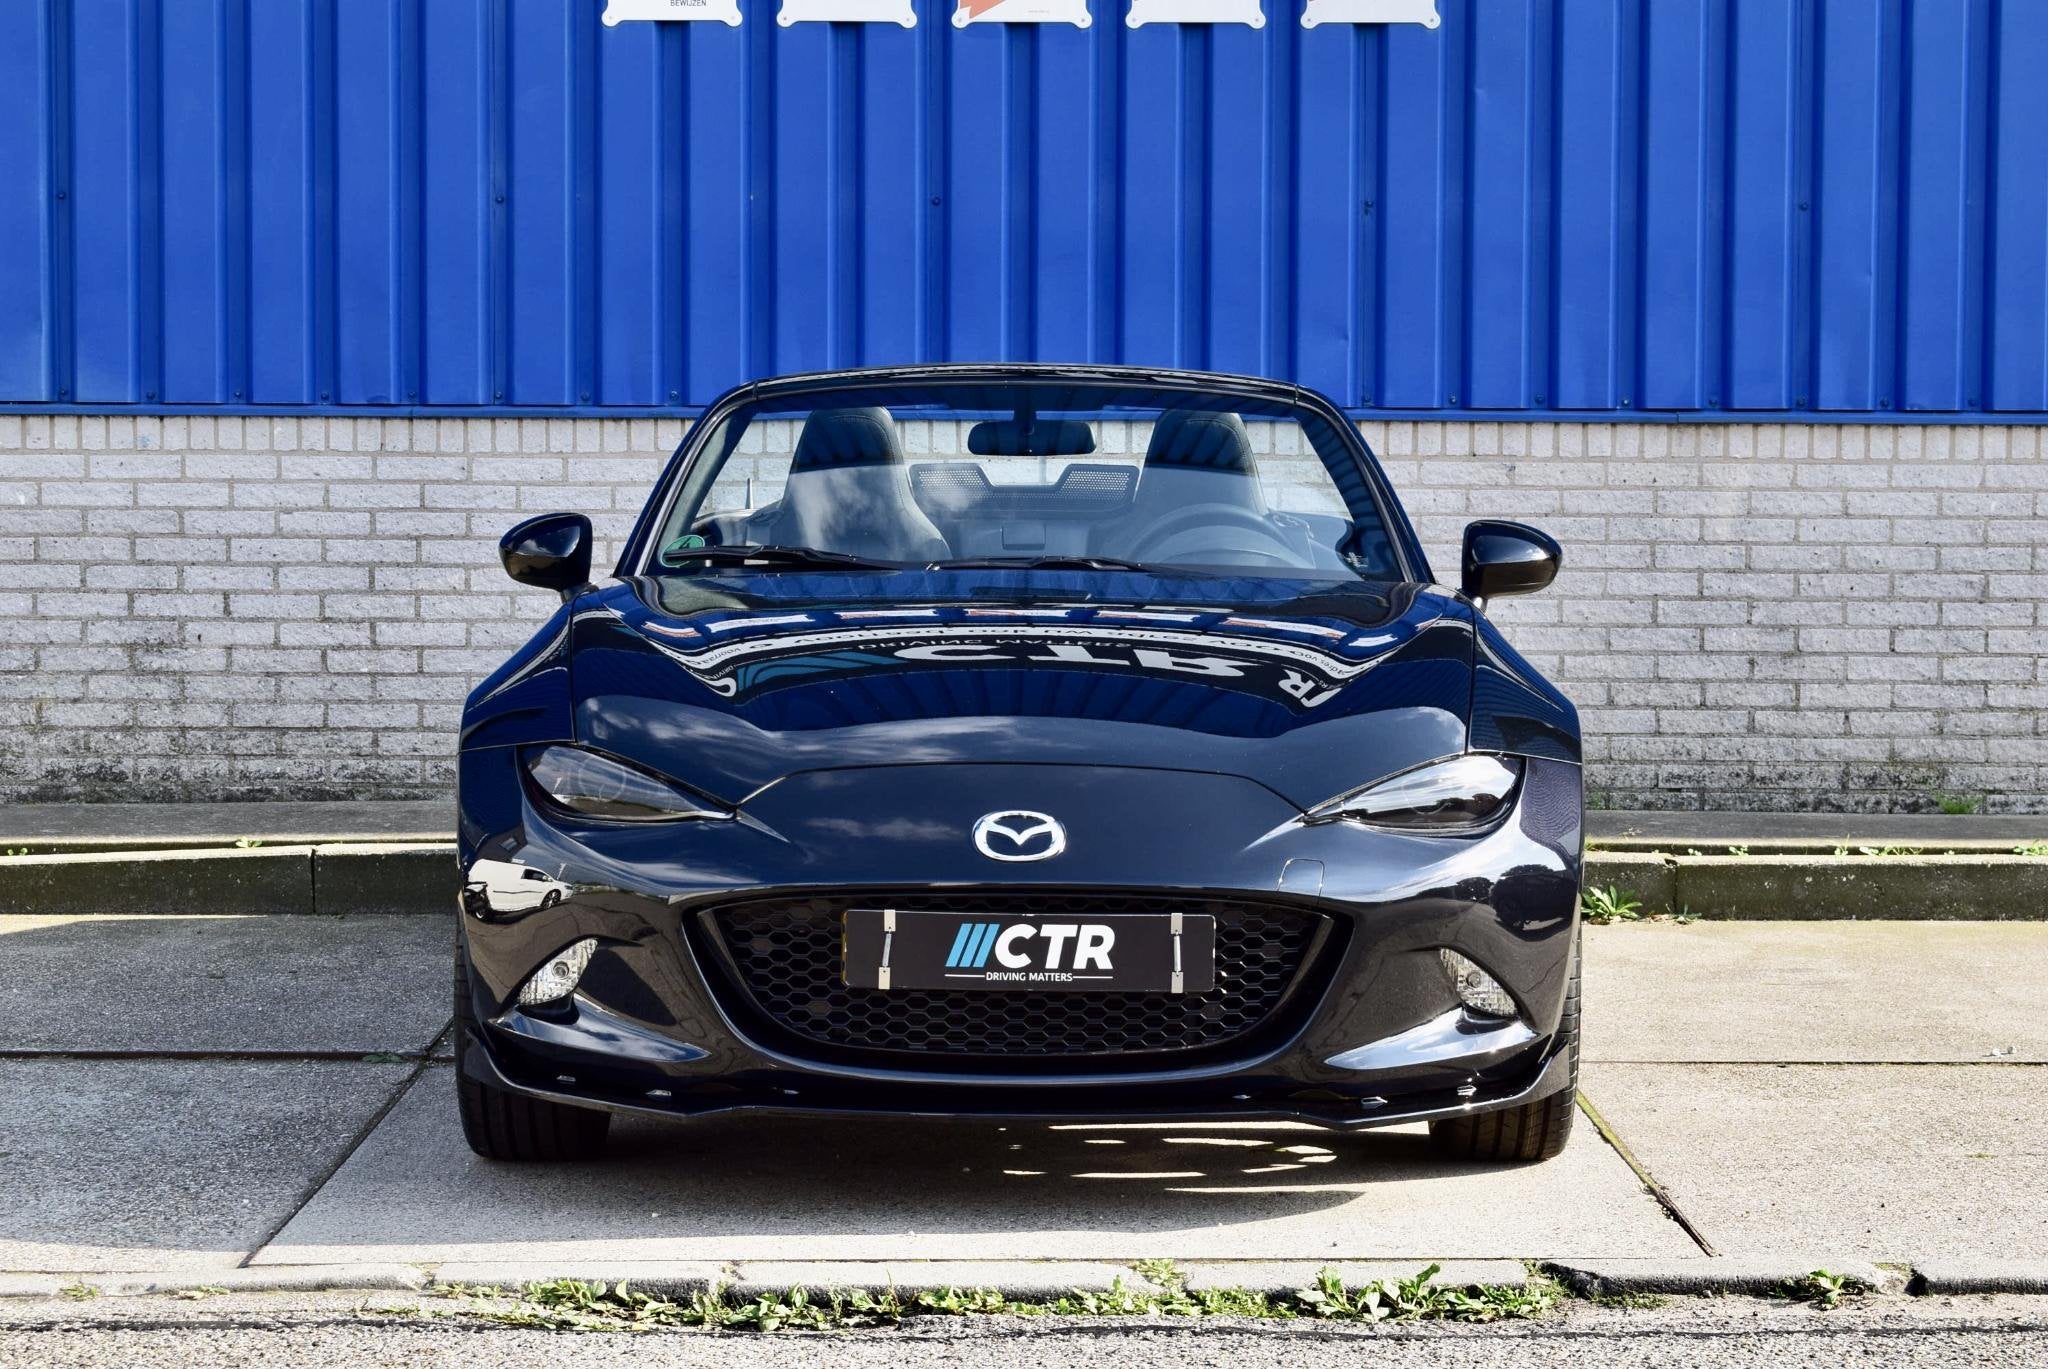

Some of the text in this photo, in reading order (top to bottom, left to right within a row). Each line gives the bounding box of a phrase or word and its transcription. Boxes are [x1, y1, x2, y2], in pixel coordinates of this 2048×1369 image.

[994, 923, 1116, 970] CTR
[986, 971, 1073, 982] DRIVING MATTERS
